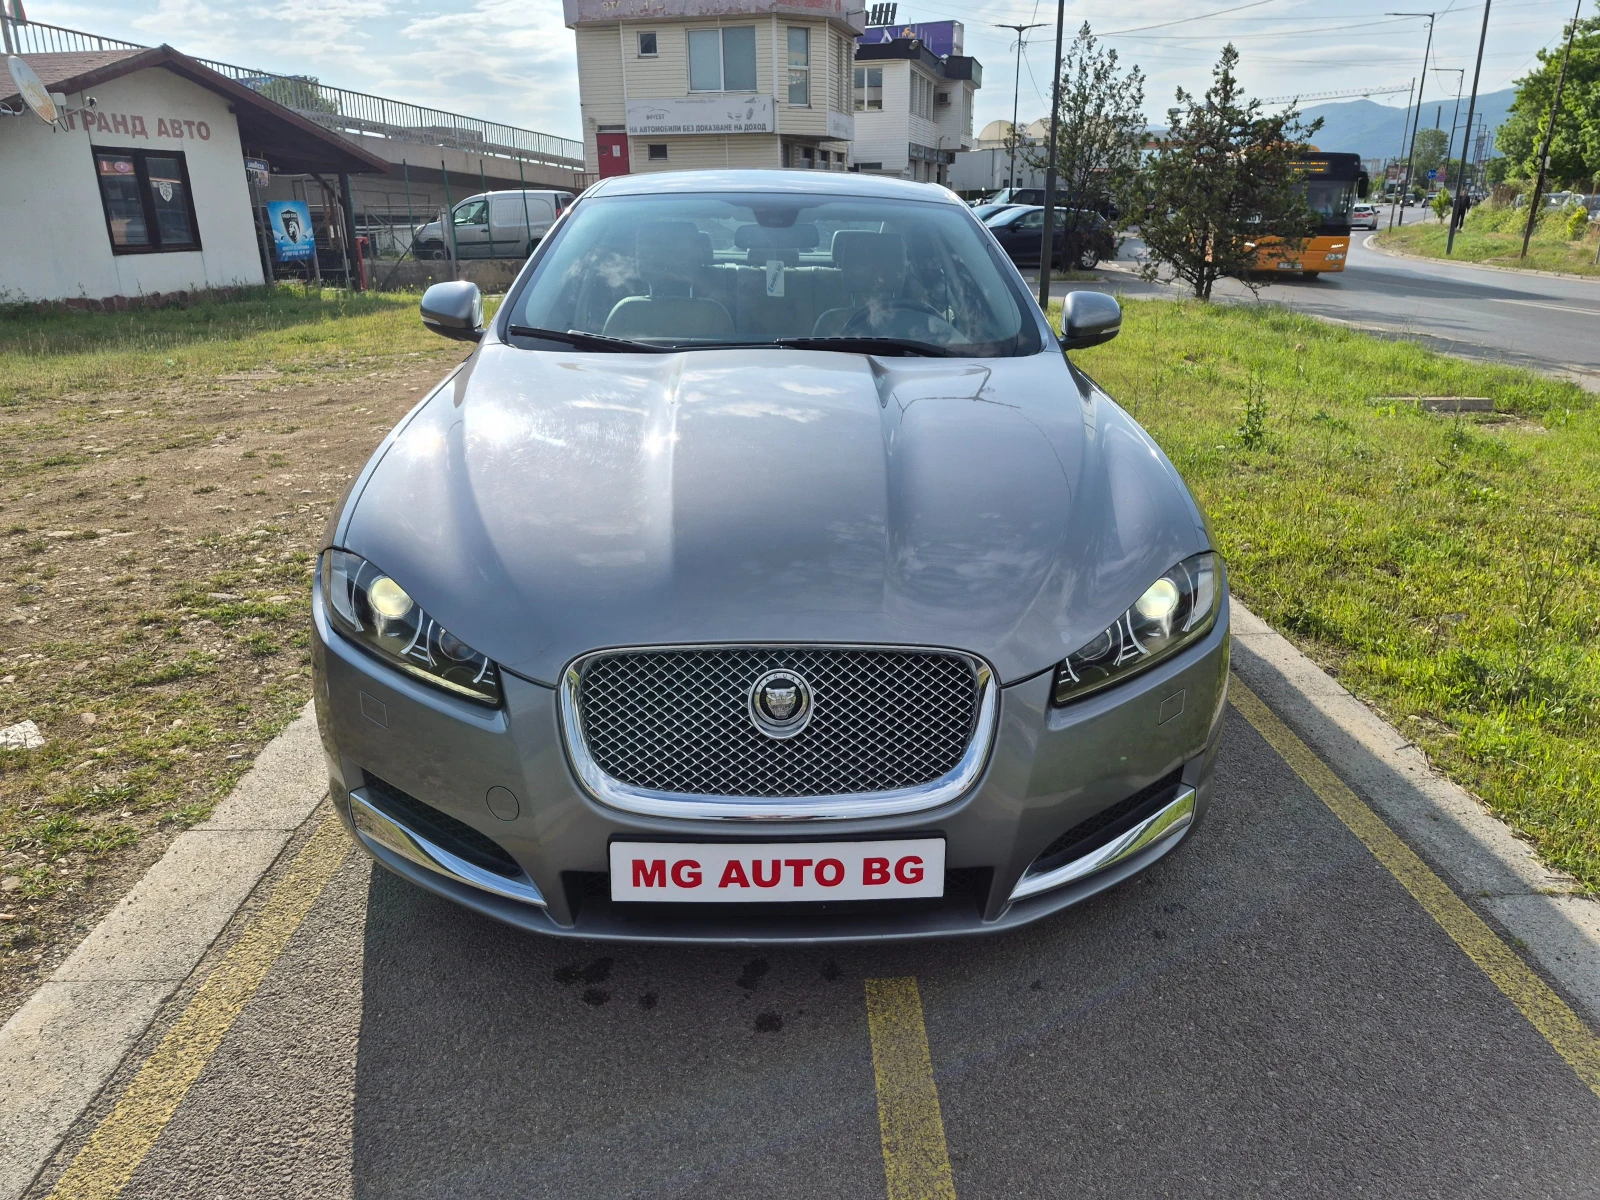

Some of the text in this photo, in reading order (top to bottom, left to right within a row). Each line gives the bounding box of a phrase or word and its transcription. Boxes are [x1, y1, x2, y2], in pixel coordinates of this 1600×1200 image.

[66, 108, 211, 141] ГРАНД АВТО
[639, 125, 682, 133] АВТОМОБИЛИ
[696, 124, 733, 132] ДОКАЗВАНЕ
[744, 123, 767, 132] ДОХОД
[760, 673, 803, 687] JAGUAR
[631, 855, 925, 888] MG AUTO BG
